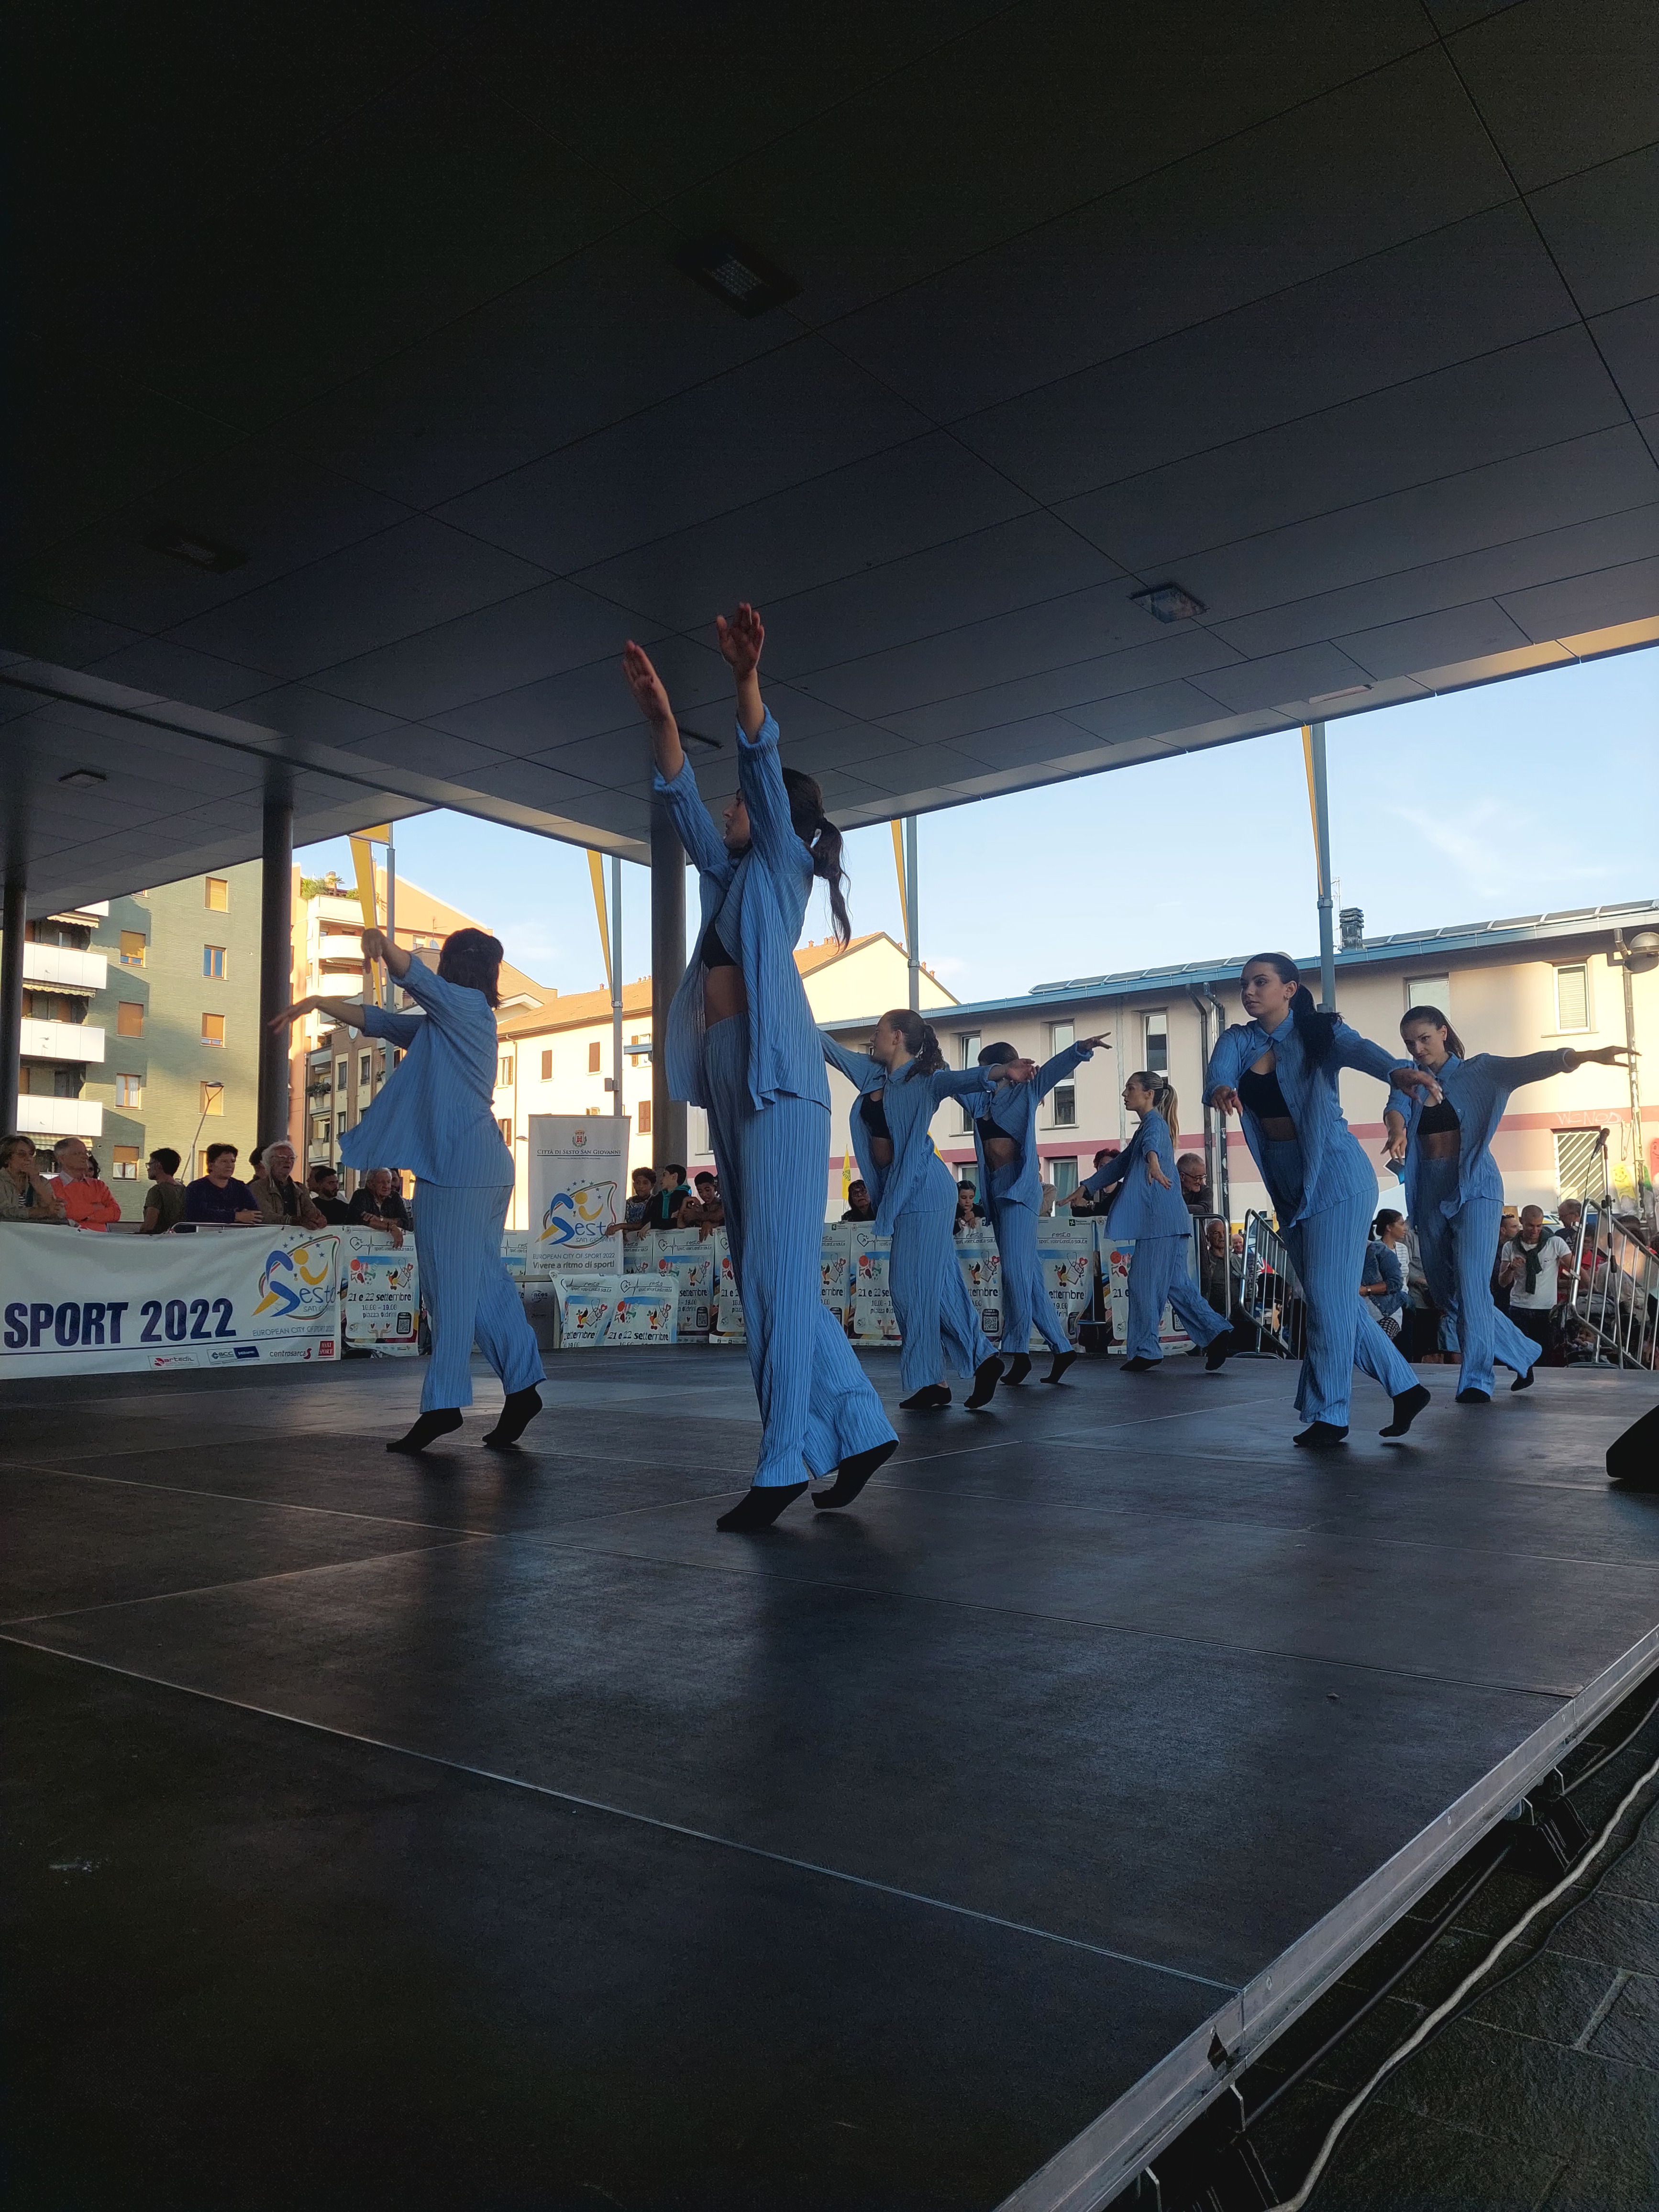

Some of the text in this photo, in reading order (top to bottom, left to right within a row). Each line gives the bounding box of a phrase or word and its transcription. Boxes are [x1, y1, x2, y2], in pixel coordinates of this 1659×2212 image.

[679, 1288, 708, 1296] settembre
[821, 1287, 843, 1296] embre
[858, 1289, 866, 1297] 21
[874, 1288, 881, 1296] 22
[1049, 1289, 1084, 1300] ettembre
[1112, 1288, 1123, 1298] 21
[347, 1293, 357, 1302] 21
[365, 1293, 375, 1301] 22
[375, 1292, 411, 1301] settembre
[4, 1298, 237, 1349] SPORT 2022
[252, 1328, 289, 1337] EUROPEAN
[623, 1331, 632, 1339] 22
[633, 1332, 669, 1341] settembre
